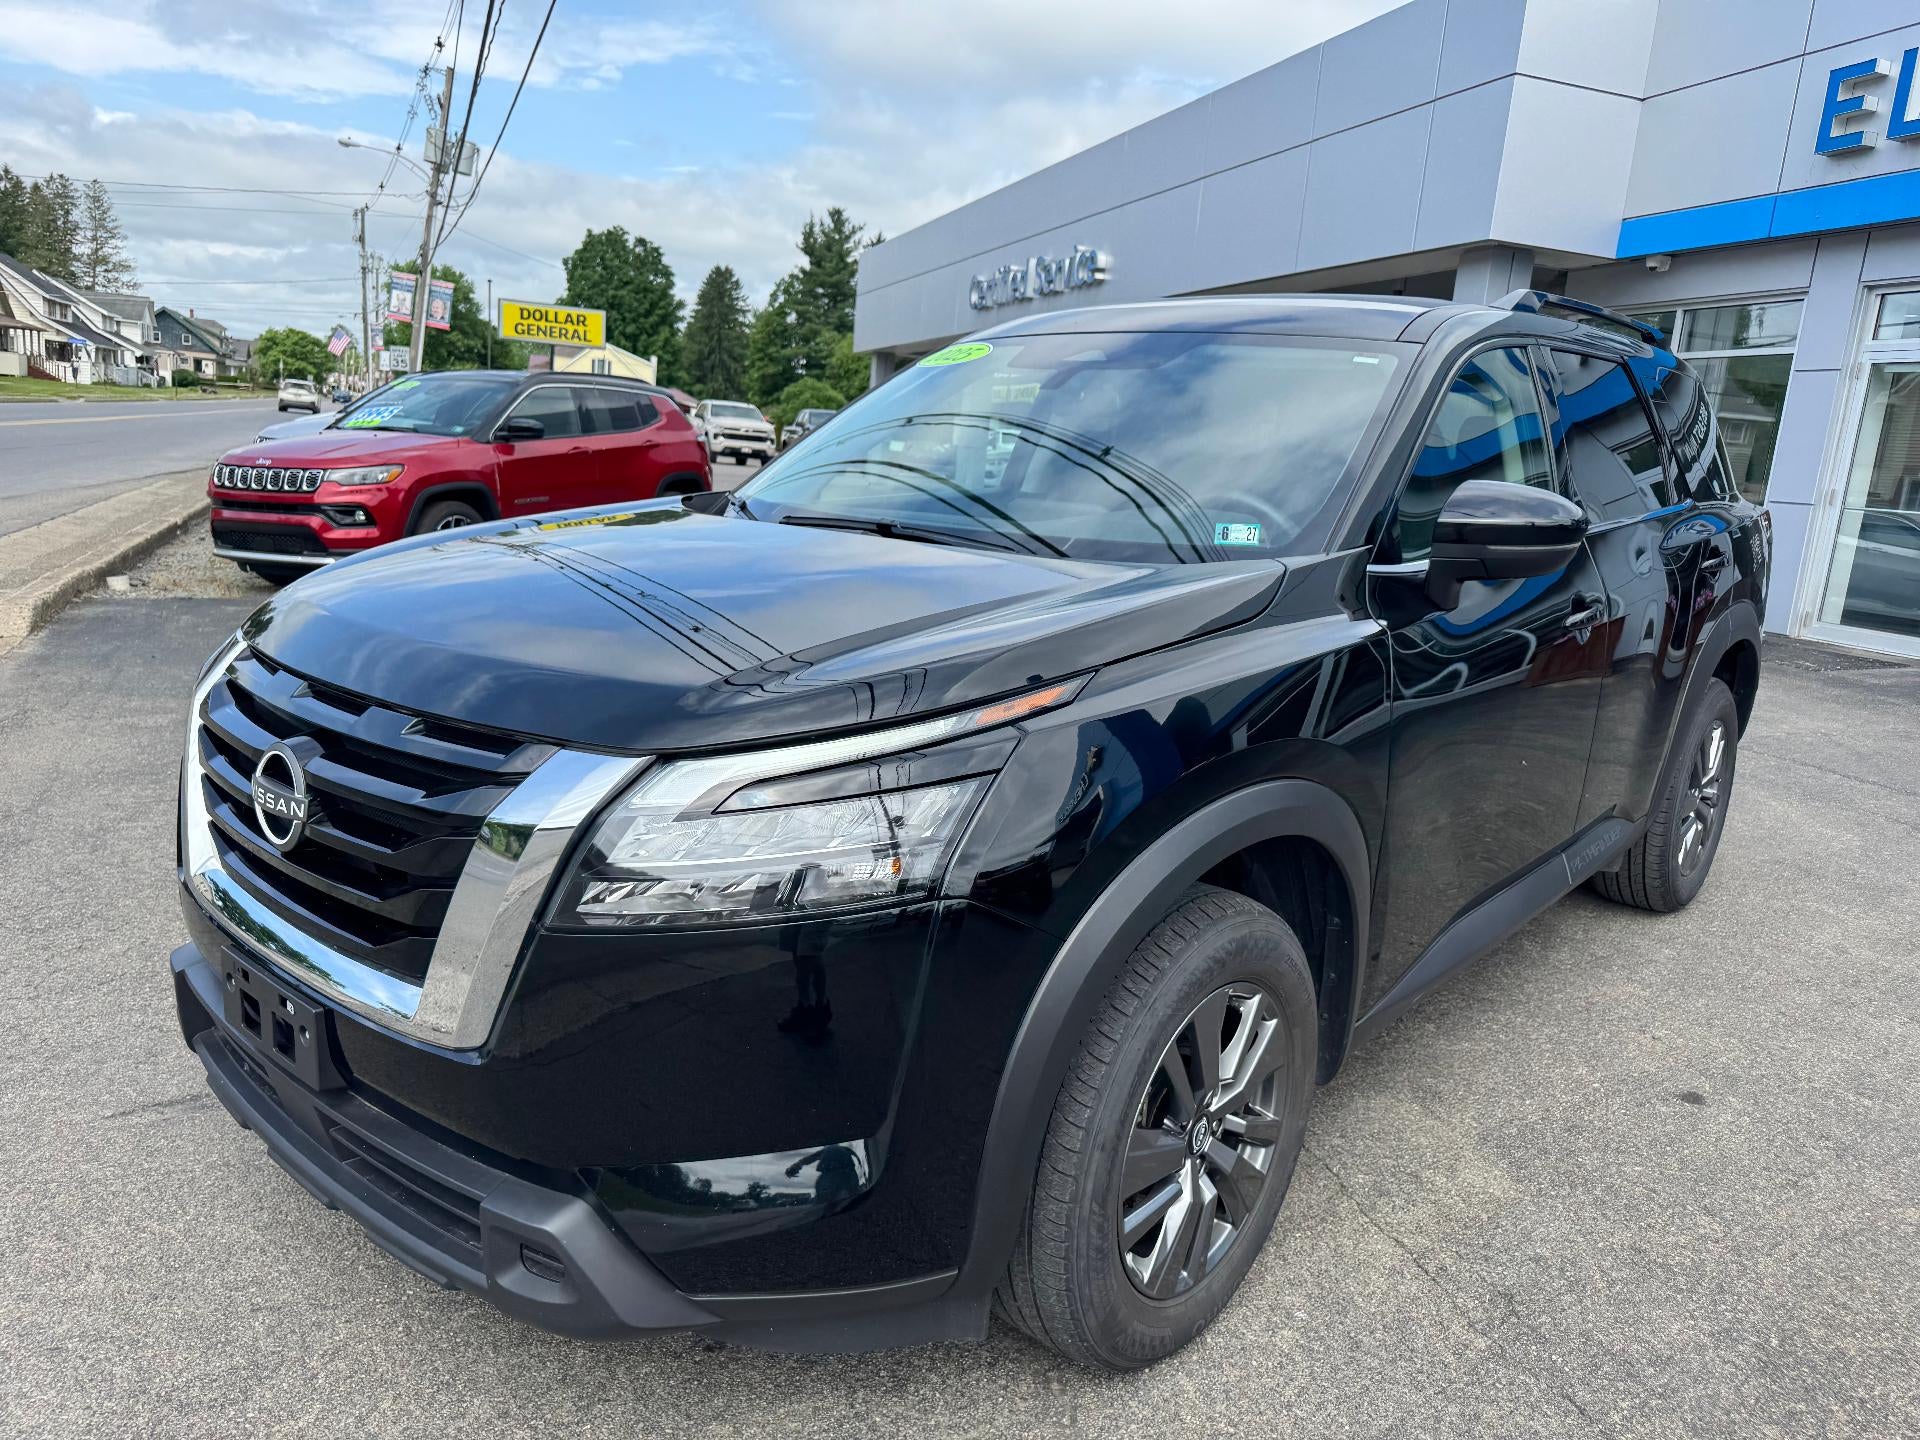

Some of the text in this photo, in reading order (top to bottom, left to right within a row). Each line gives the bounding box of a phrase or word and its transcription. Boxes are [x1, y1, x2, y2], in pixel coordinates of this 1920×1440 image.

[970, 245, 1104, 310] Certified Service
[519, 306, 588, 327] DOLLAR
[514, 322, 592, 342] GENERAL
[392, 358, 408, 368] 35
[1222, 526, 1229, 541] 6
[1246, 527, 1256, 541] 27
